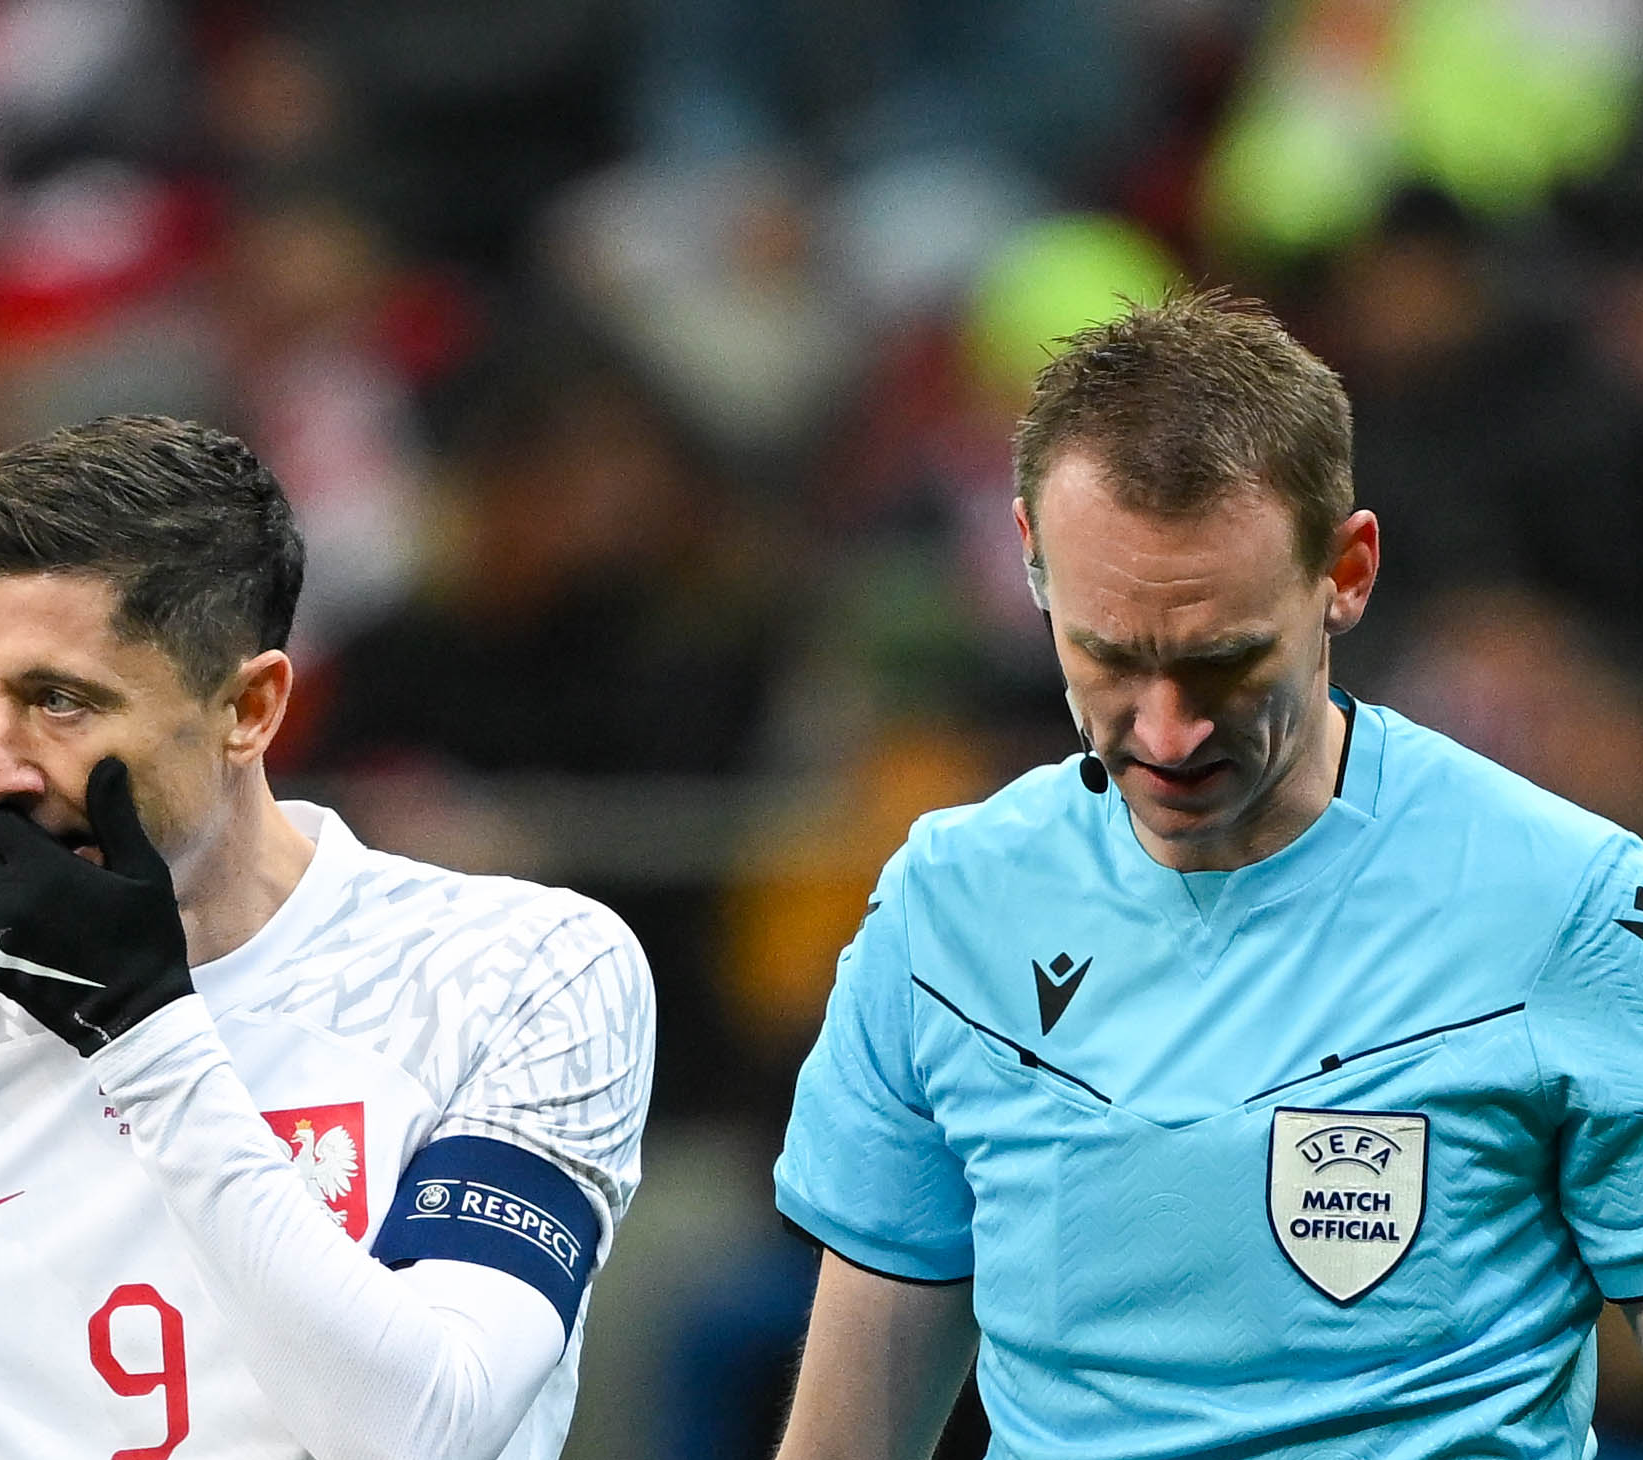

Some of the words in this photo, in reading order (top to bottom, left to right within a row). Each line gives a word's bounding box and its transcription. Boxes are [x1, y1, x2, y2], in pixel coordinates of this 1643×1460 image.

[1301, 1133, 1391, 1168] UEFA
[1302, 1190, 1391, 1211] MATCH
[461, 1190, 580, 1268] RESPECT
[1290, 1219, 1400, 1240] OFFICIAL
